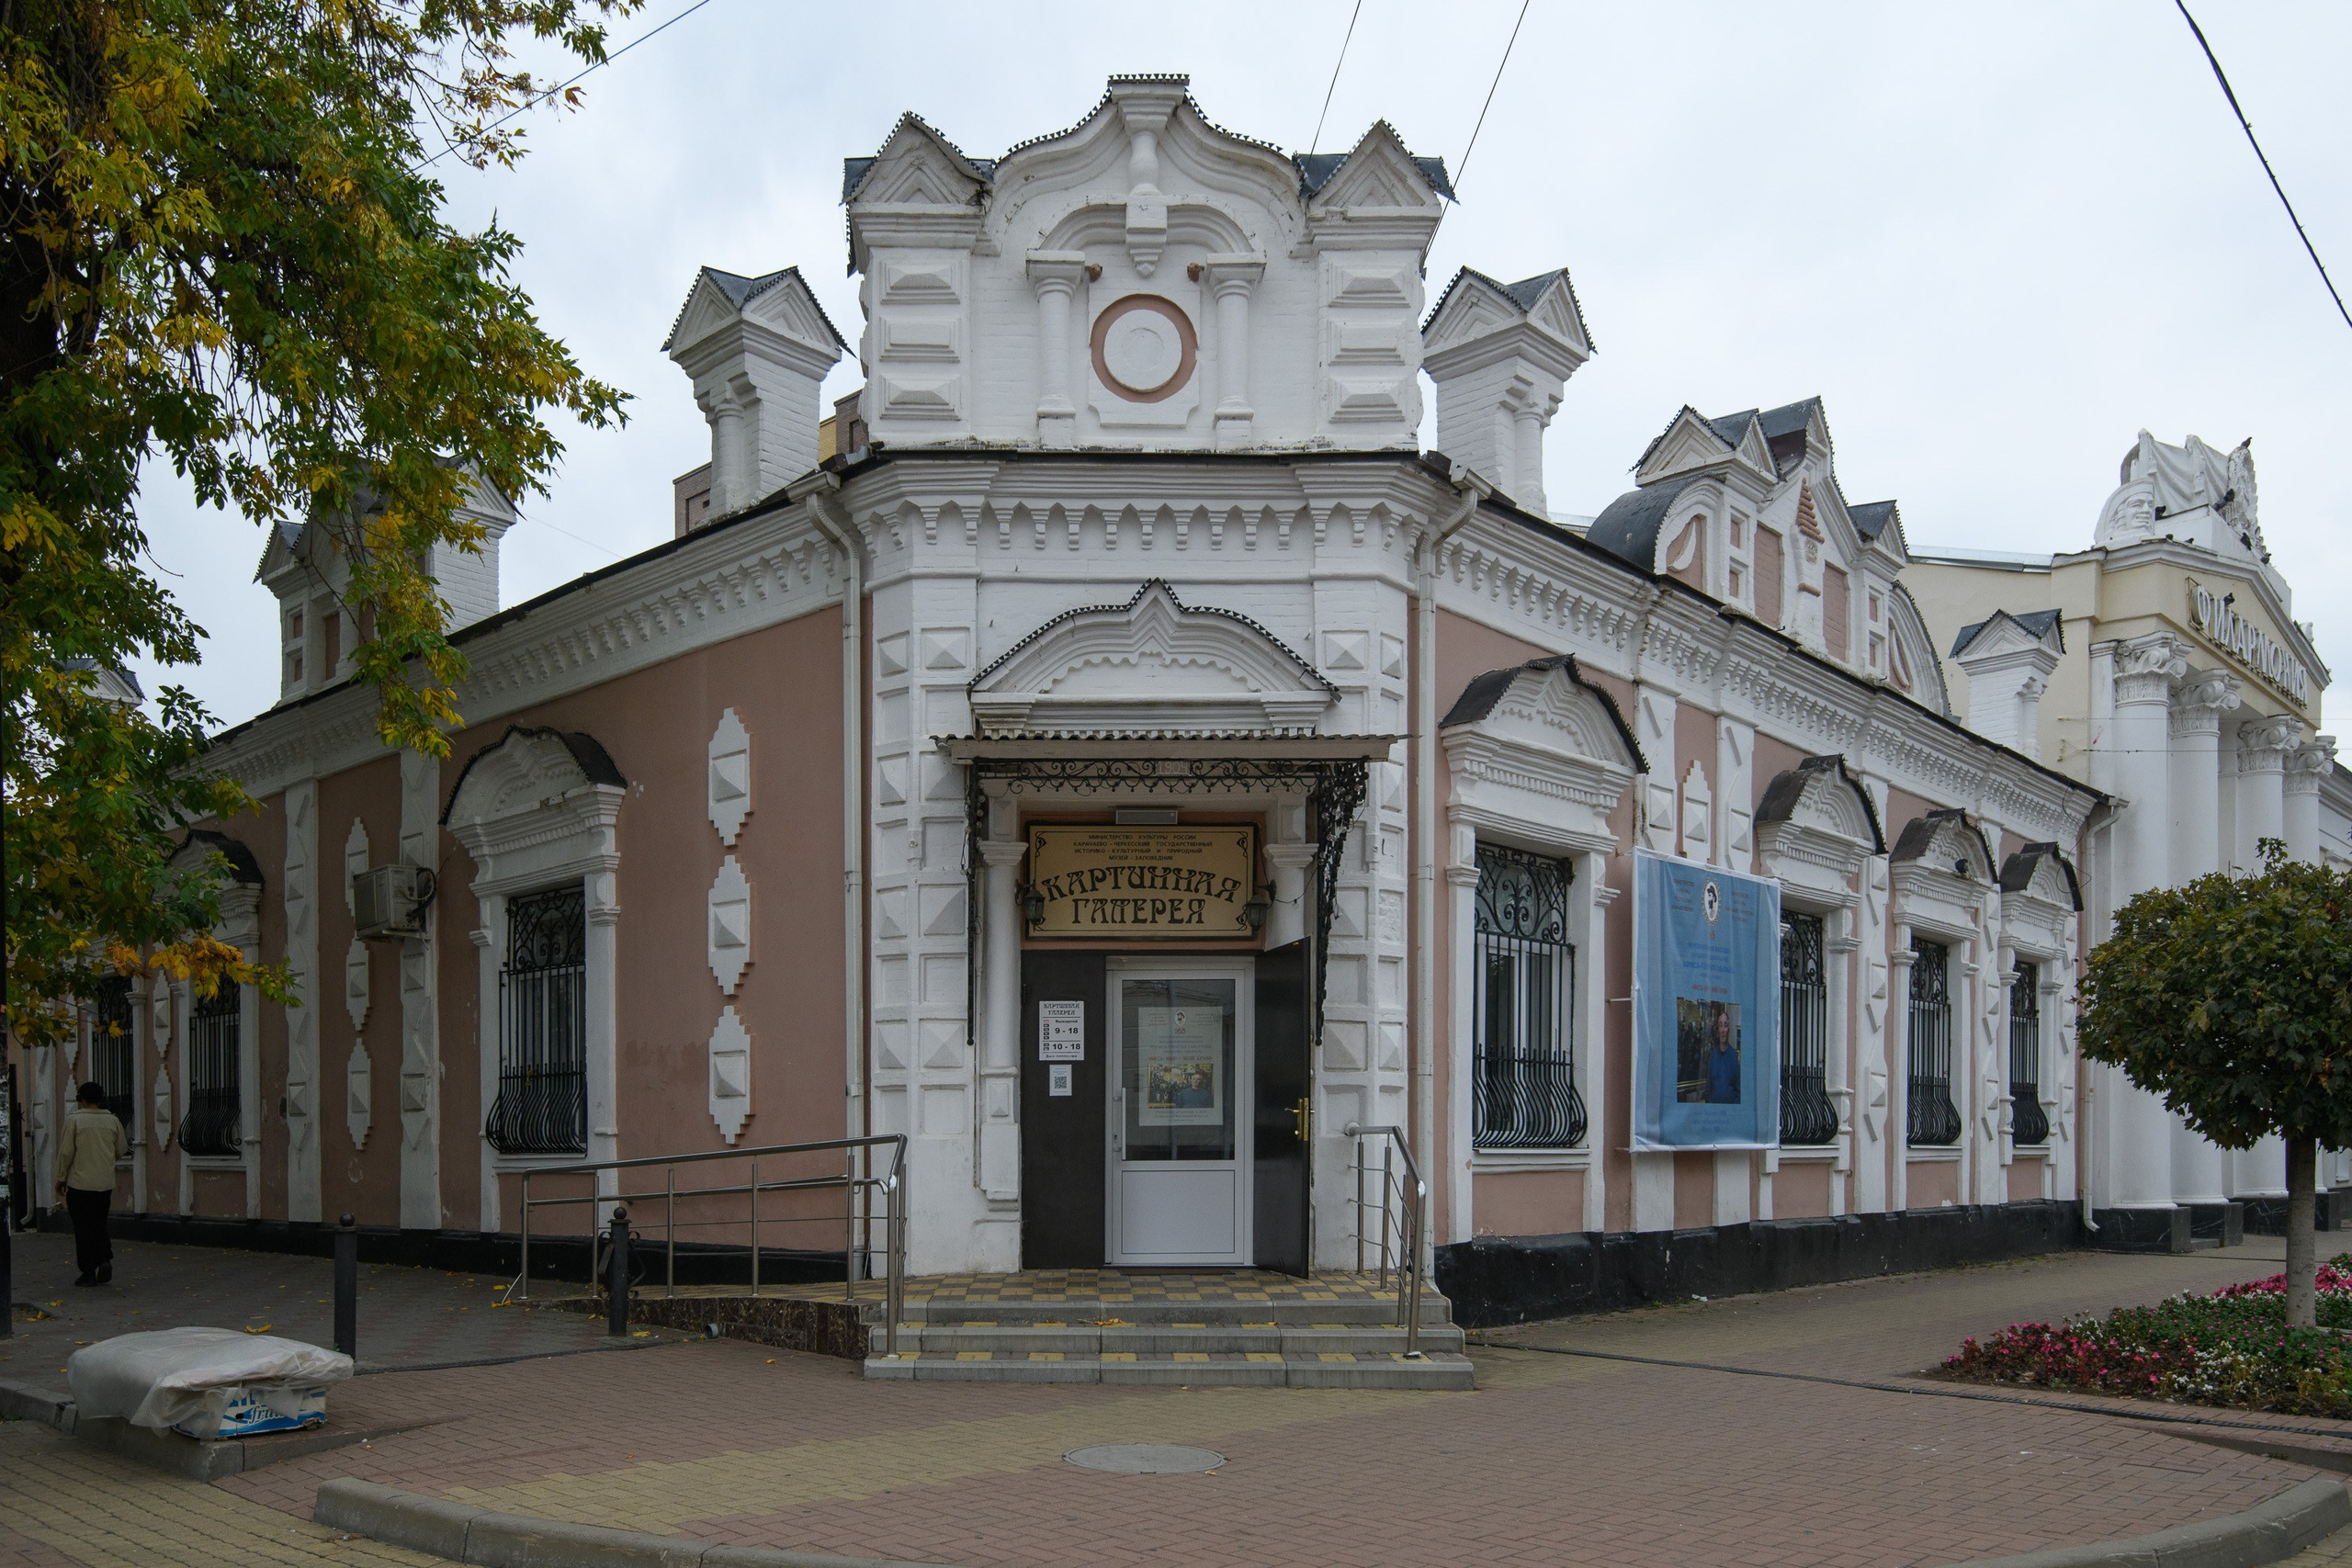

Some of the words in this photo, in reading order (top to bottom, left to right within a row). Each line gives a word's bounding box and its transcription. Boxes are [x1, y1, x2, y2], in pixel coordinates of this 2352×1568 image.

[2193, 584, 2309, 705] ФИЛАРМОНИЯ
[1158, 761, 1188, 774] 1904
[1041, 865, 1242, 903] КАРТИННАЯ
[1071, 898, 1206, 924] ГАЛЕРЕЯ
